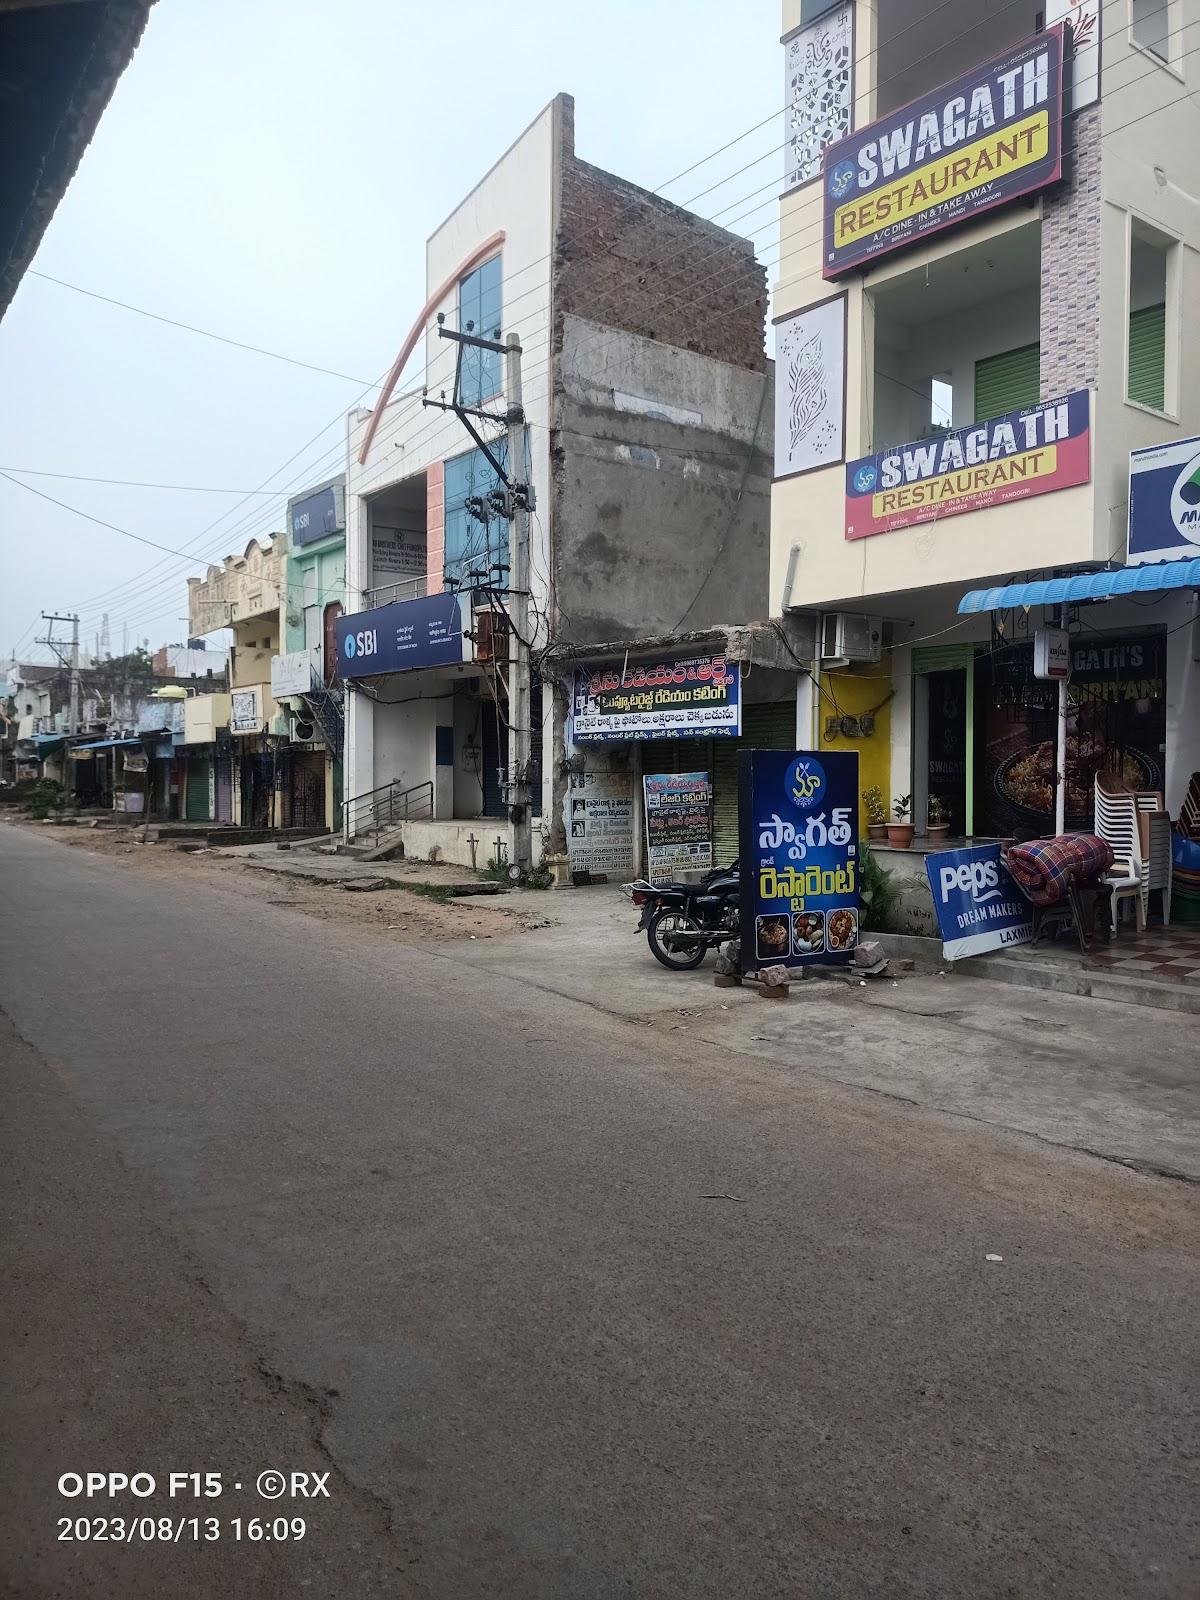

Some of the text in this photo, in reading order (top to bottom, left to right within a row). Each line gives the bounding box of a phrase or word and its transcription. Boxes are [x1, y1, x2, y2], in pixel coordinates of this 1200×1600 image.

[857, 52, 1048, 188] SWAGATH
[840, 123, 1042, 238] RESTAURANT
[873, 228, 890, 242] A/C
[892, 219, 913, 234] DINE
[938, 196, 962, 214] TAKE
[964, 183, 993, 203] AWAY
[881, 404, 1069, 489] SWAGATH
[882, 452, 1043, 512] RESTAURANT
[300, 512, 310, 528] SBI
[356, 628, 377, 657] SBI
[655, 689, 691, 704] రేడియం
[759, 808, 852, 859] స్వాగత్
[760, 861, 855, 911] రెస్టారెంట్
[957, 903, 1022, 929] DREAM MAKERS
